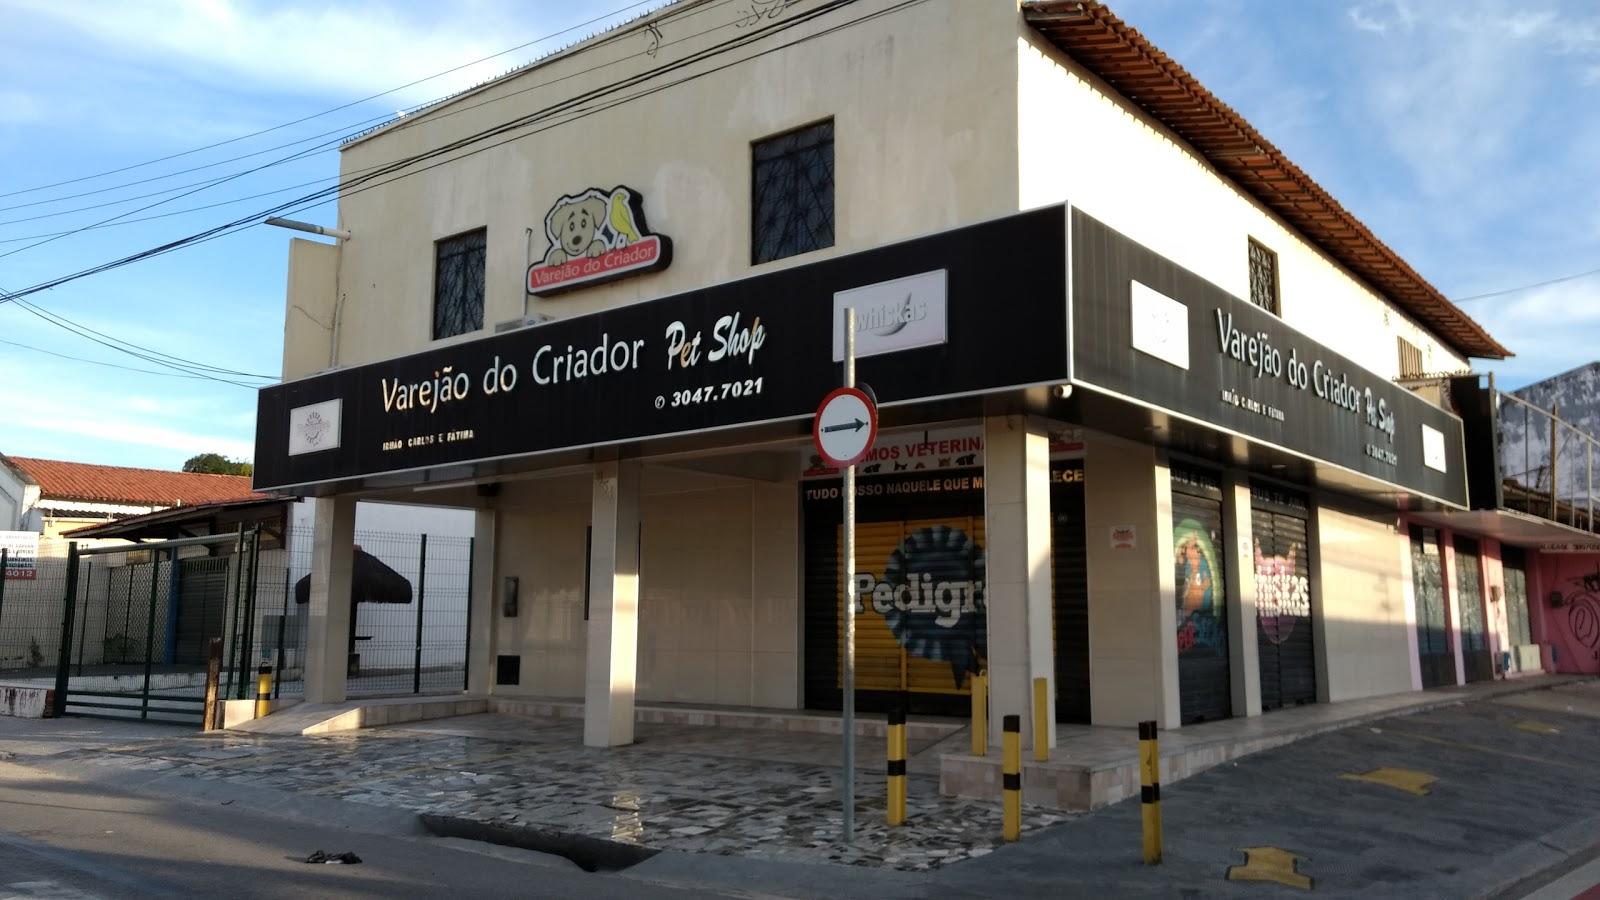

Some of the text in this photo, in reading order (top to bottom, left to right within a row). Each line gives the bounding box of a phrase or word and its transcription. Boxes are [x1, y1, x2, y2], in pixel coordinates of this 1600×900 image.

[533, 245, 655, 286] Varejão do Criador
[856, 302, 928, 332] whiskas
[380, 311, 767, 414] Varejão do Criador Pet Shop
[1216, 307, 1282, 378] Varejão
[1288, 347, 1308, 390] do
[1313, 359, 1361, 413] Criador
[671, 377, 764, 408] 3047.7021
[438, 433, 445, 443] E
[904, 436, 985, 457] VETERIN
[806, 487, 838, 500] TUDO
[887, 479, 941, 495] NAQUELE
[943, 478, 970, 491] QUE
